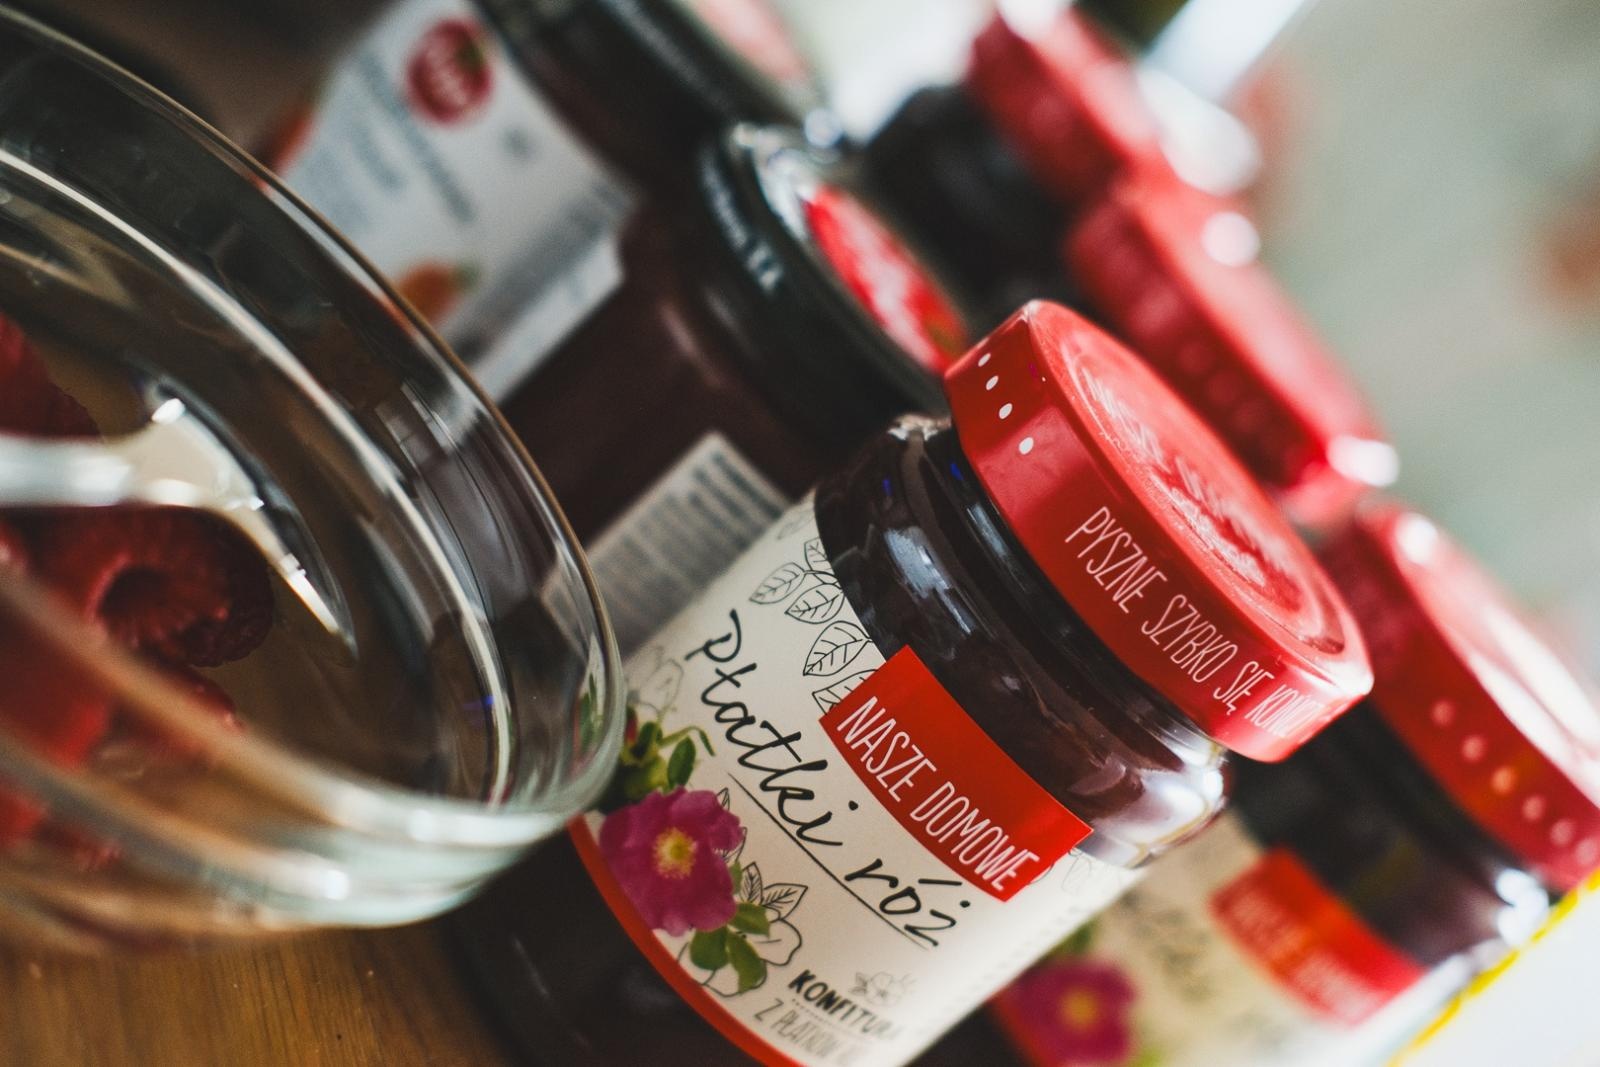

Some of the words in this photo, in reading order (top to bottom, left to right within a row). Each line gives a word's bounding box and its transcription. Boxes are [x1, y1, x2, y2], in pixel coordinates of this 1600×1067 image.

[1065, 506, 1168, 613] PYSZNE
[1141, 594, 1238, 683] SZYBKO
[1213, 660, 1275, 715] SIĘ
[684, 608, 859, 847] Płatki
[845, 858, 970, 946] róż
[836, 696, 938, 802] NASZE
[909, 781, 1040, 891] DOMOWE
[754, 997, 784, 1022] Z
